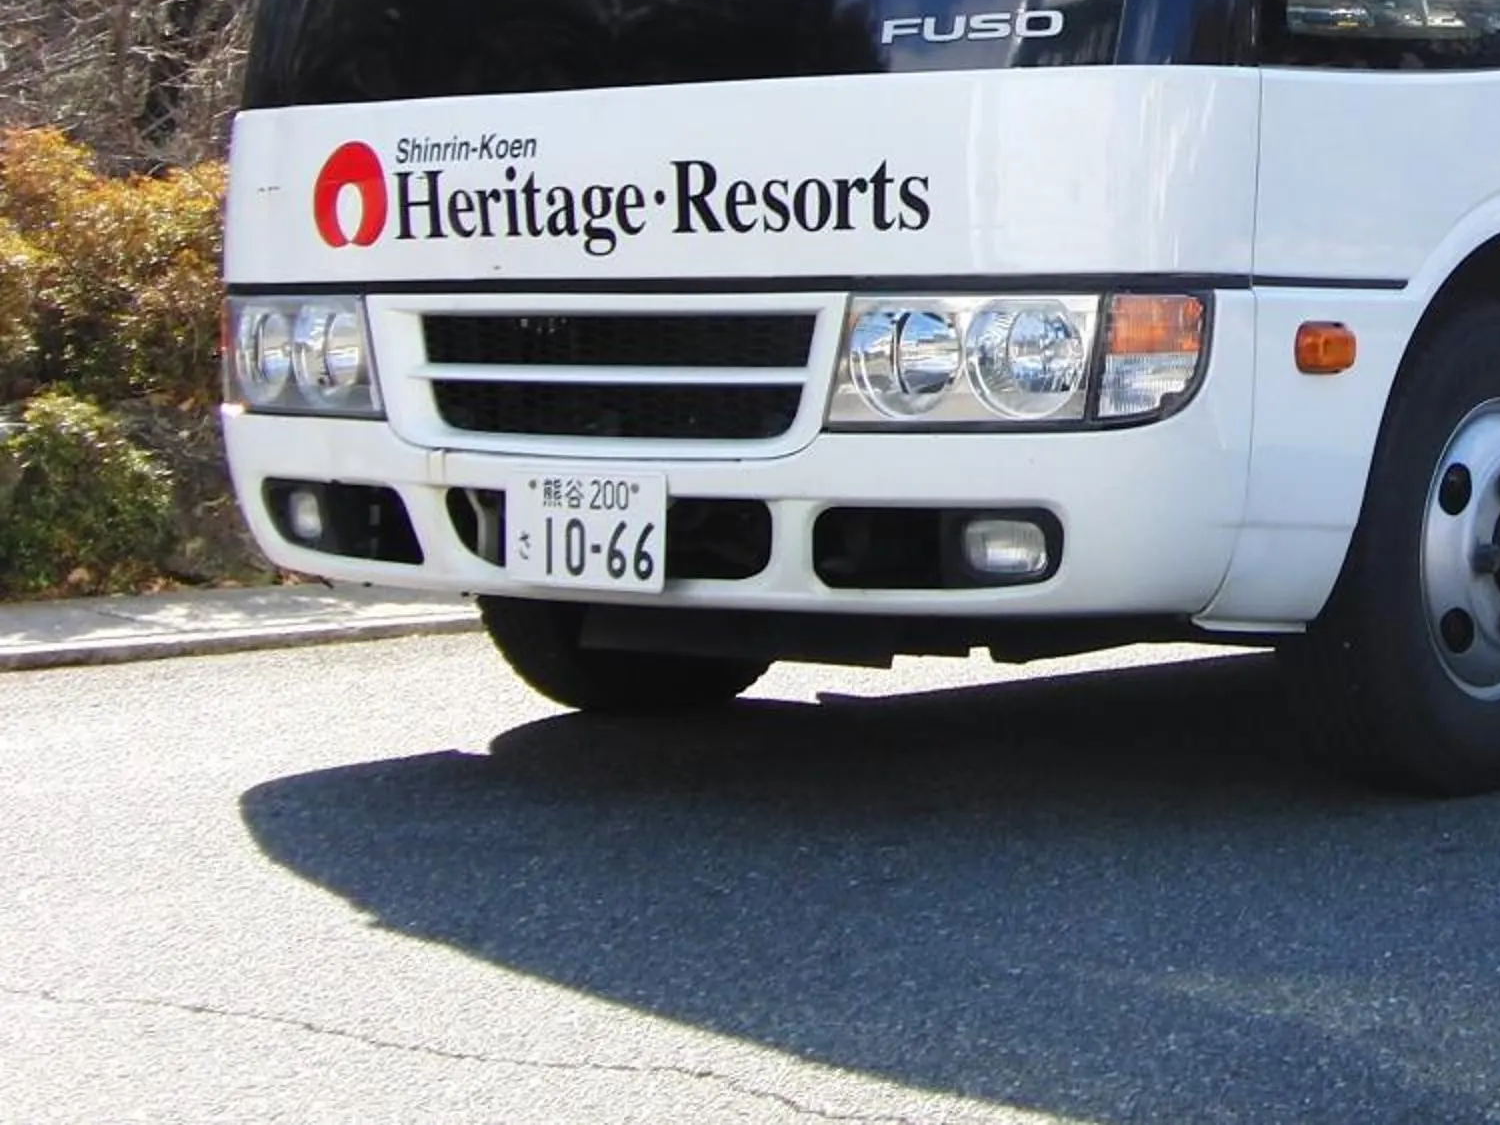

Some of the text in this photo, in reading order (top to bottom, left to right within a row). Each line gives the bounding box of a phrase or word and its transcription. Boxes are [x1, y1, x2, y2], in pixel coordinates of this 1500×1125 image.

[881, 10, 1065, 44] FUSO
[395, 133, 538, 163] Shinrin-Koen
[543, 478, 629, 510] 熊谷 200
[546, 517, 656, 580] 10-66
